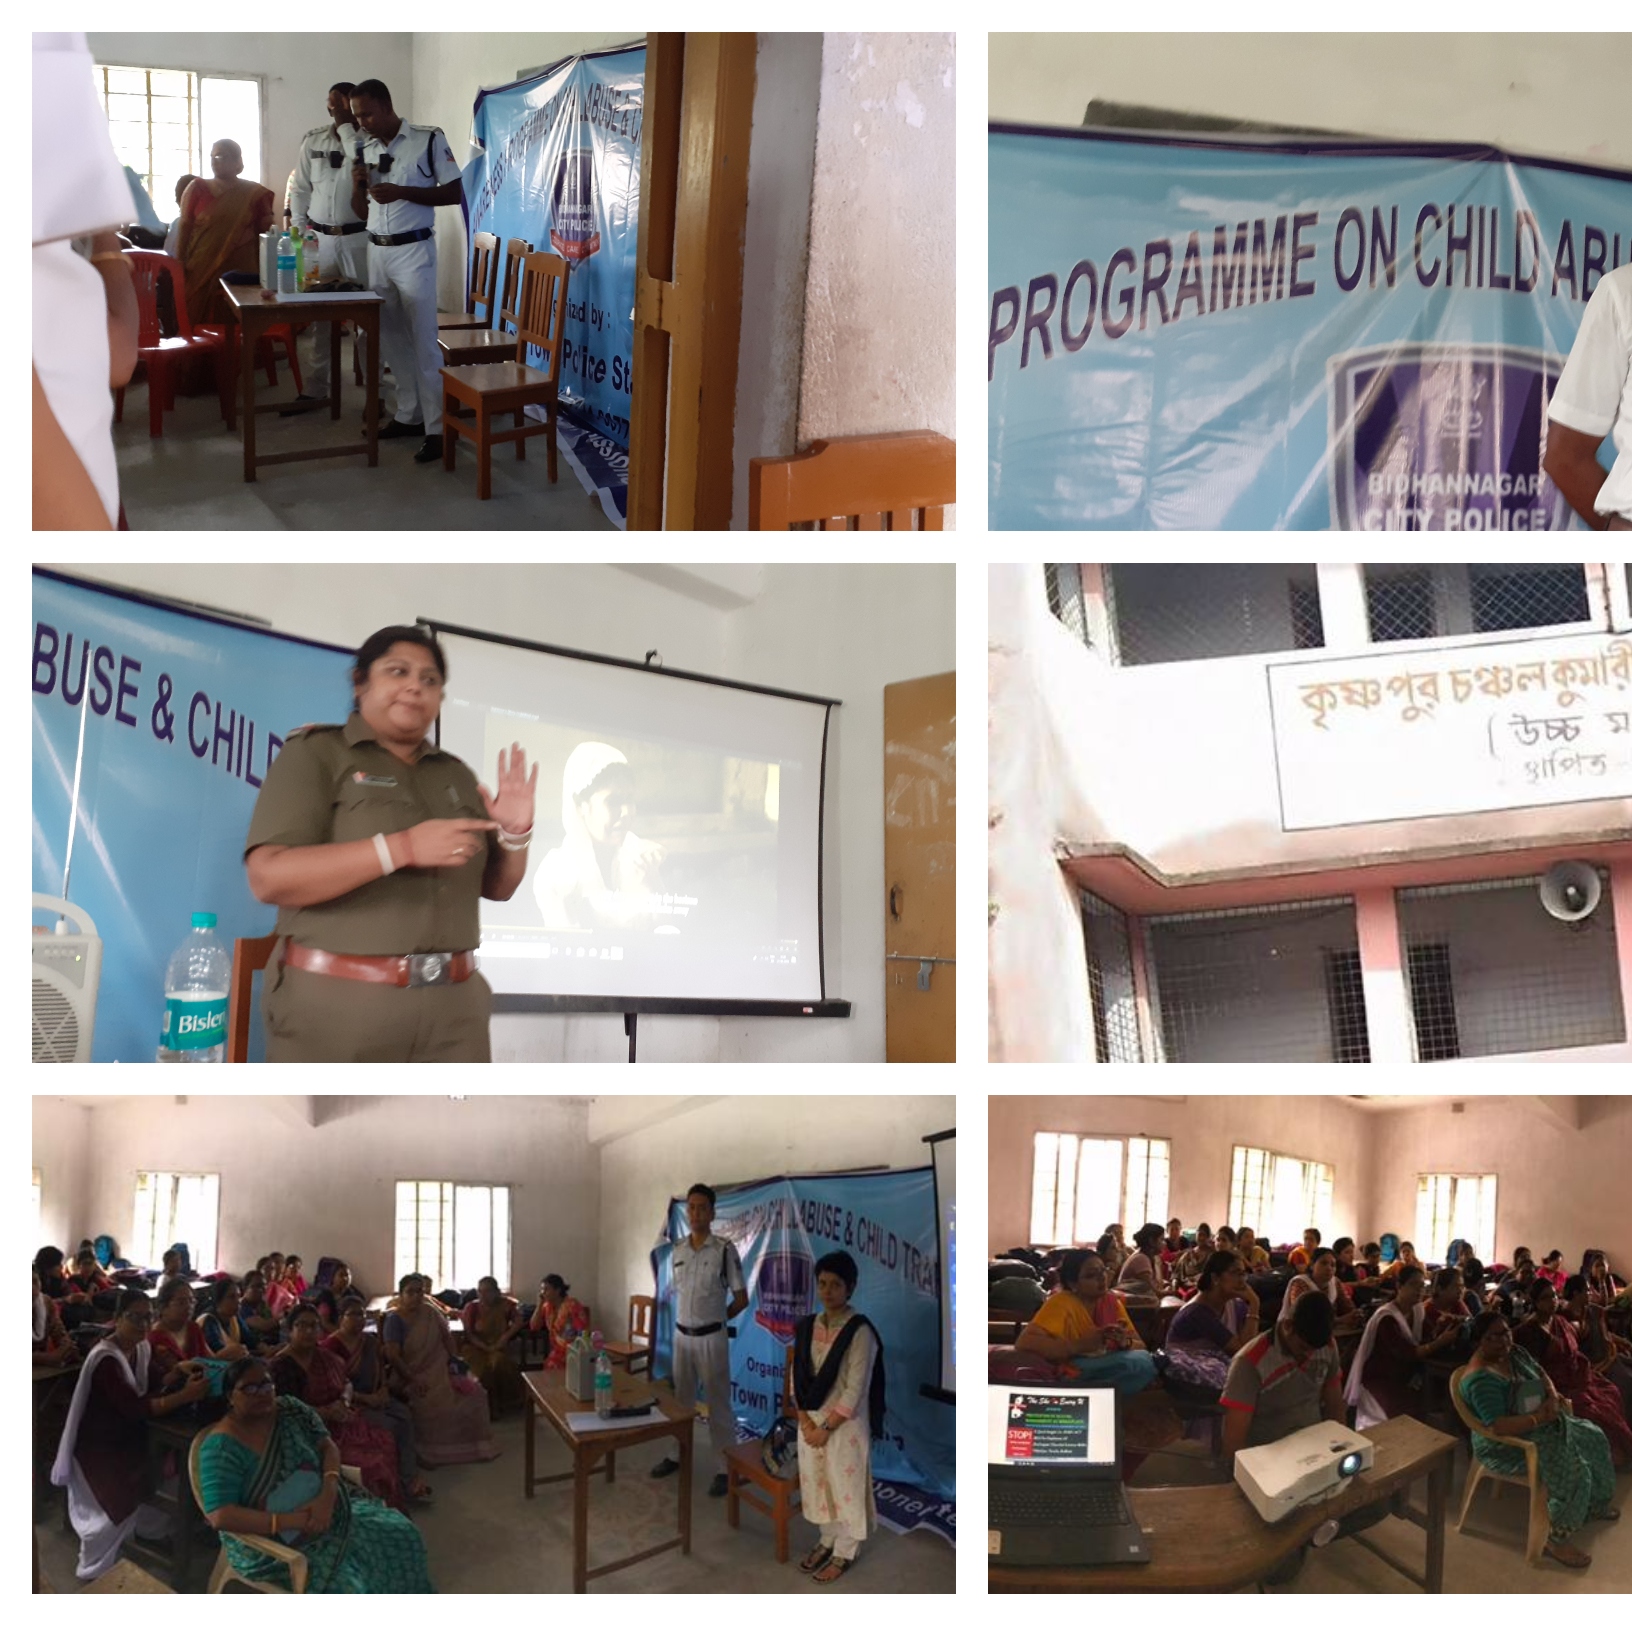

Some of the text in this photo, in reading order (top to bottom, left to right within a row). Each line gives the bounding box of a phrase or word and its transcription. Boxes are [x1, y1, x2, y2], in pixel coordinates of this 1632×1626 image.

[988, 211, 1319, 382] PROGRAMME
[1334, 205, 1398, 292] ON
[1413, 203, 1540, 293] CHILD
[591, 303, 605, 331] by
[1367, 473, 1543, 497] BIDHANNAGAR
[1363, 508, 1547, 531] CITY POLICE
[32, 621, 142, 728] BUSE
[151, 672, 175, 744] &
[800, 1199, 841, 1242] ABUSE
[844, 1211, 854, 1246] &
[857, 1217, 898, 1269] CHILD
[730, 1382, 768, 1411] Town
[1008, 1429, 1034, 1441] STOP!
